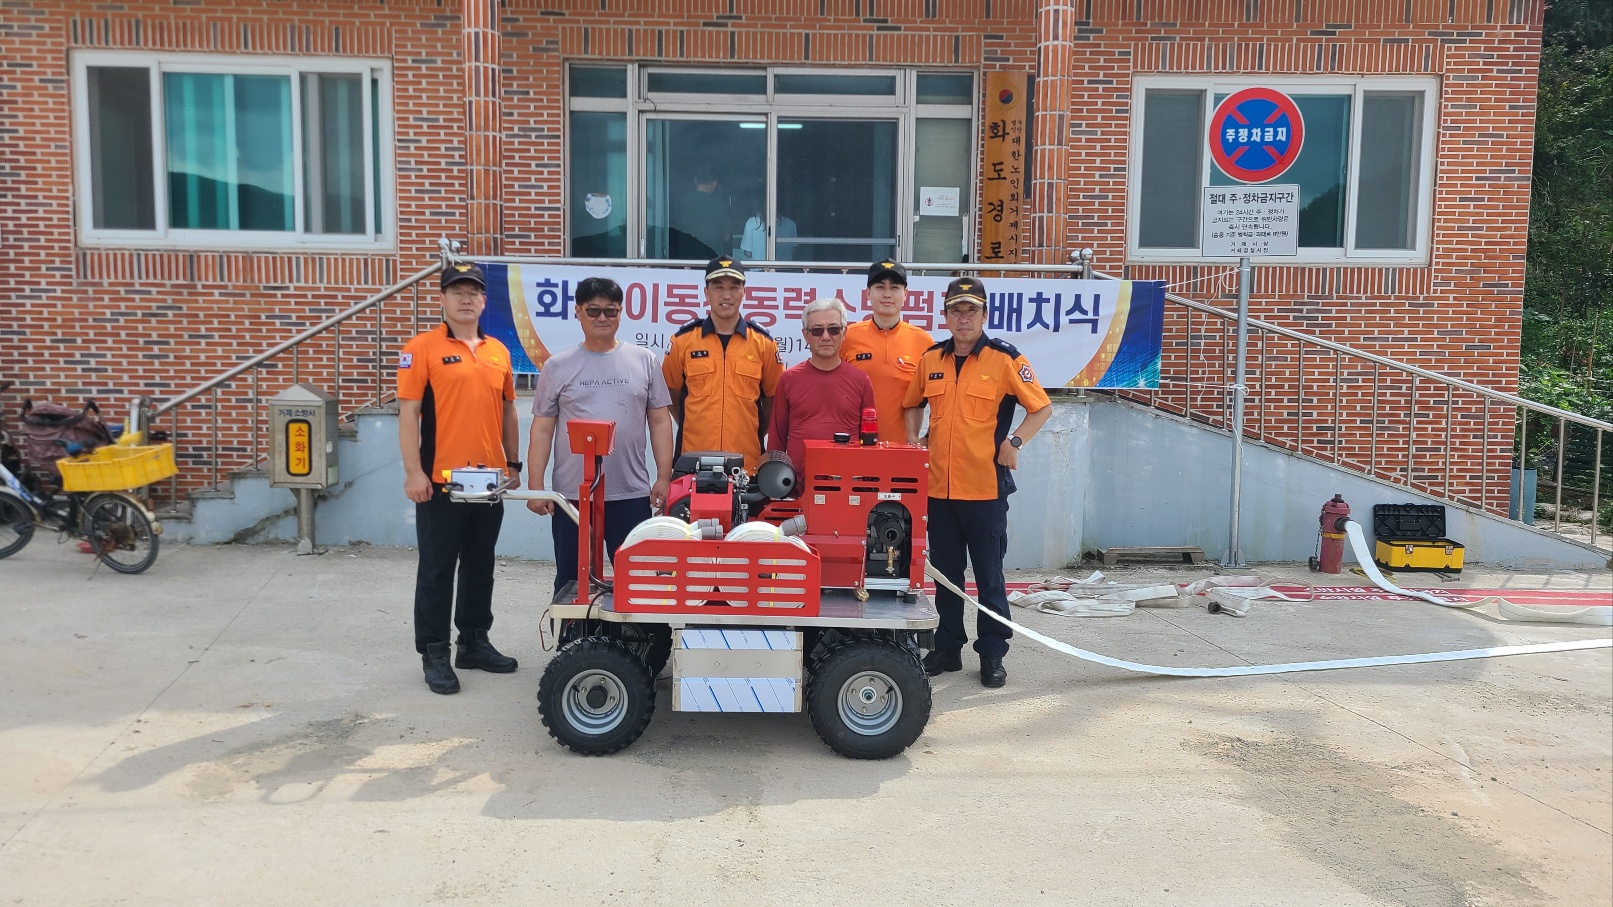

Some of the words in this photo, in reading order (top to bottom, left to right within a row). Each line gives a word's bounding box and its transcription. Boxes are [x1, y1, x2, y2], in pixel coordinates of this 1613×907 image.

[1226, 127, 1287, 143] 주정차금지
[1209, 193, 1226, 205] 절대
[988, 292, 1101, 334] 배치식
[635, 332, 664, 349] 일시
[278, 409, 293, 417] 거제
[294, 409, 316, 417] 소방서
[294, 426, 306, 469] 소화기
